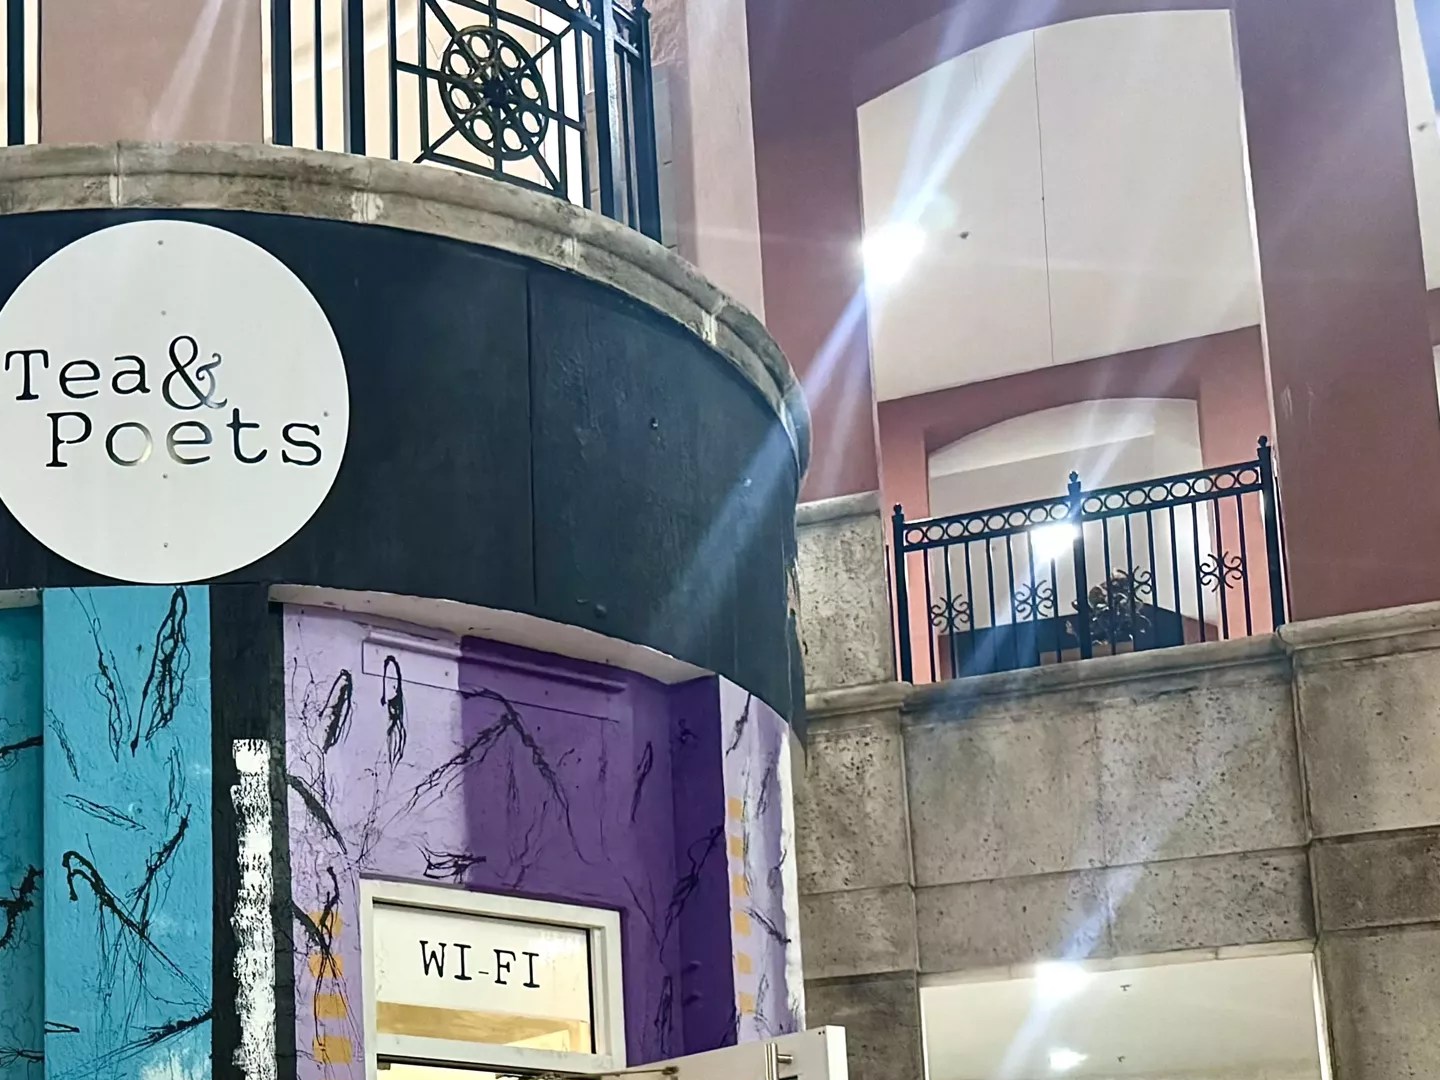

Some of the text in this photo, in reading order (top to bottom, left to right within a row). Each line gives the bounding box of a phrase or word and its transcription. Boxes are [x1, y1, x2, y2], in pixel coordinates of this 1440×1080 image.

[4, 335, 227, 410] Tea&
[45, 407, 322, 467] Poets
[419, 940, 541, 989] WI-FI
